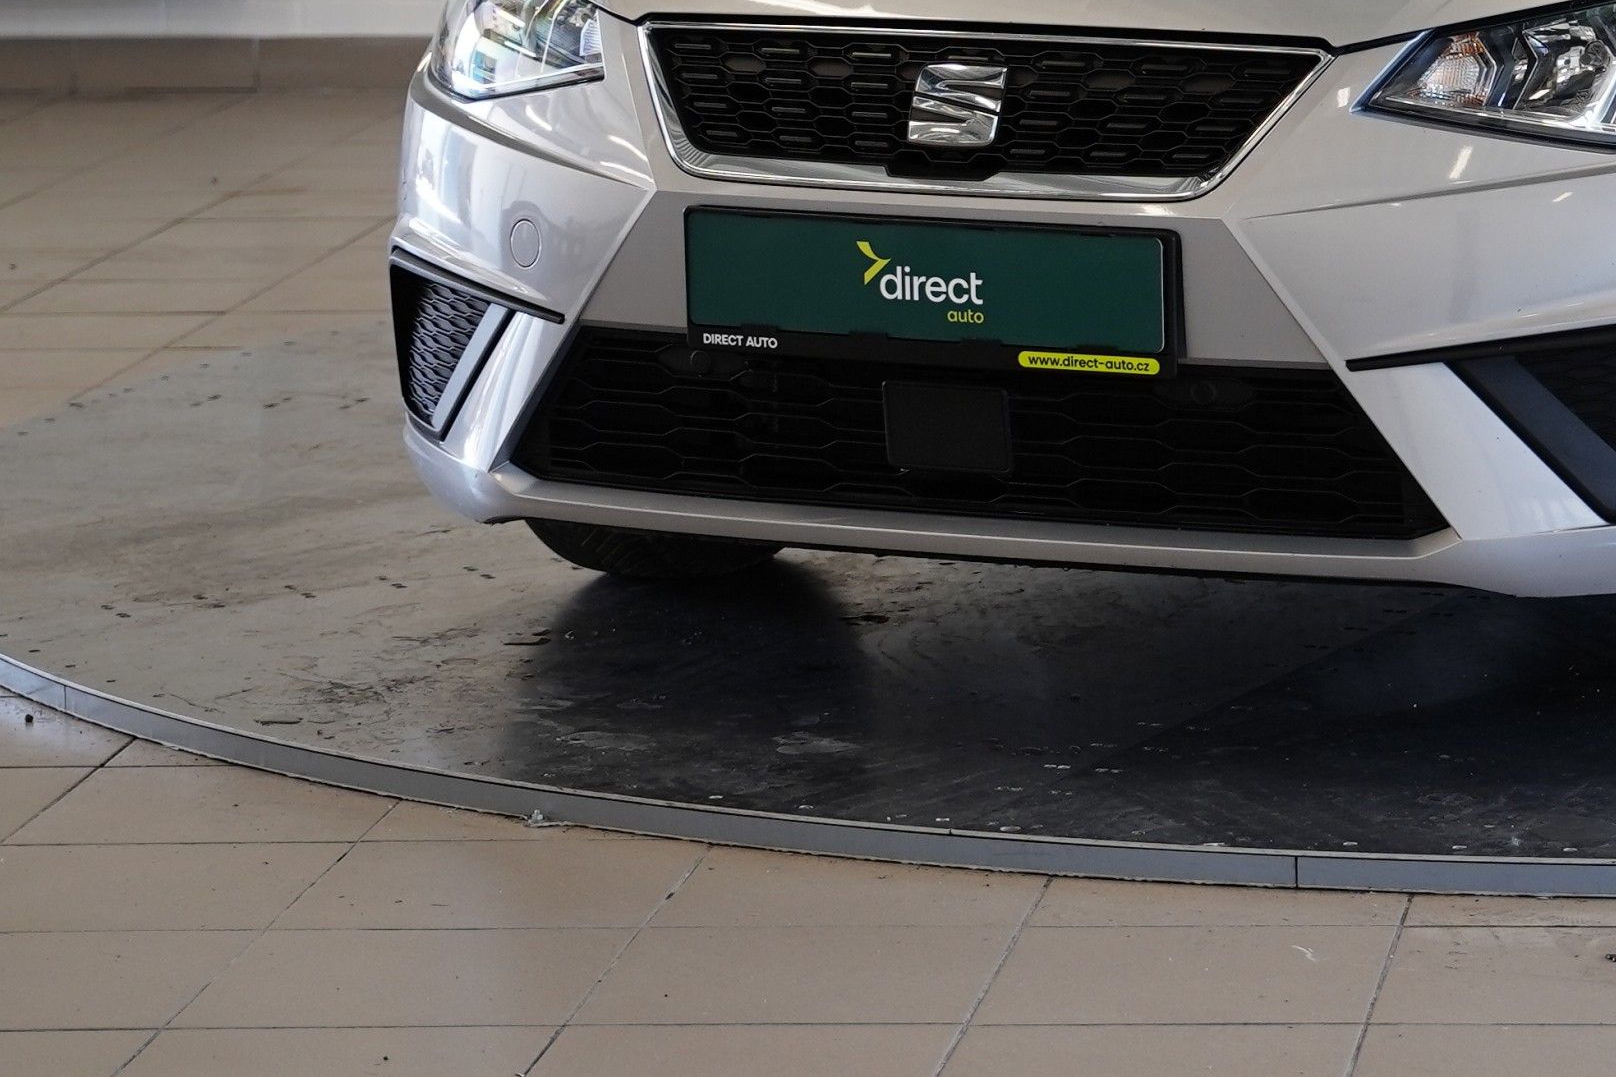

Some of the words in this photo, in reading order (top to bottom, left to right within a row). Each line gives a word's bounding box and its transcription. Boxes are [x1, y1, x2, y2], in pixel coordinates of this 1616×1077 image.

[879, 265, 984, 305] direct
[947, 309, 985, 323] auto
[703, 333, 744, 346] DIRECT
[745, 336, 778, 348] AUTO
[1027, 355, 1150, 372] www.direct-auto.cz
